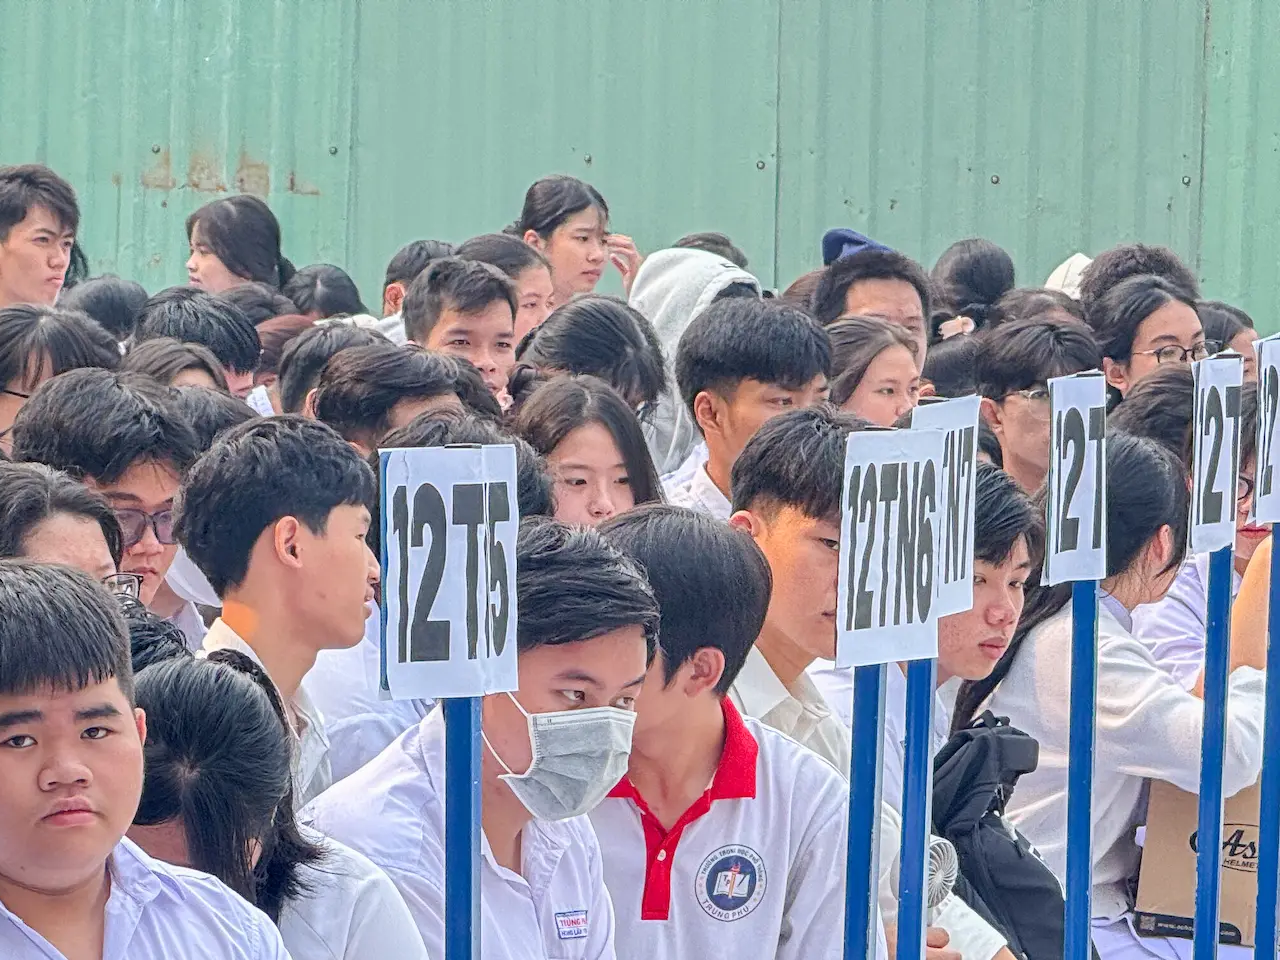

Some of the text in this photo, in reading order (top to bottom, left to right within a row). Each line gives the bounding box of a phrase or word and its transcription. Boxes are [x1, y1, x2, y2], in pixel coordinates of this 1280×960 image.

[393, 482, 509, 663] 12T5
[846, 459, 936, 631] 12TN6
[1223, 858, 1258, 869] HELME
